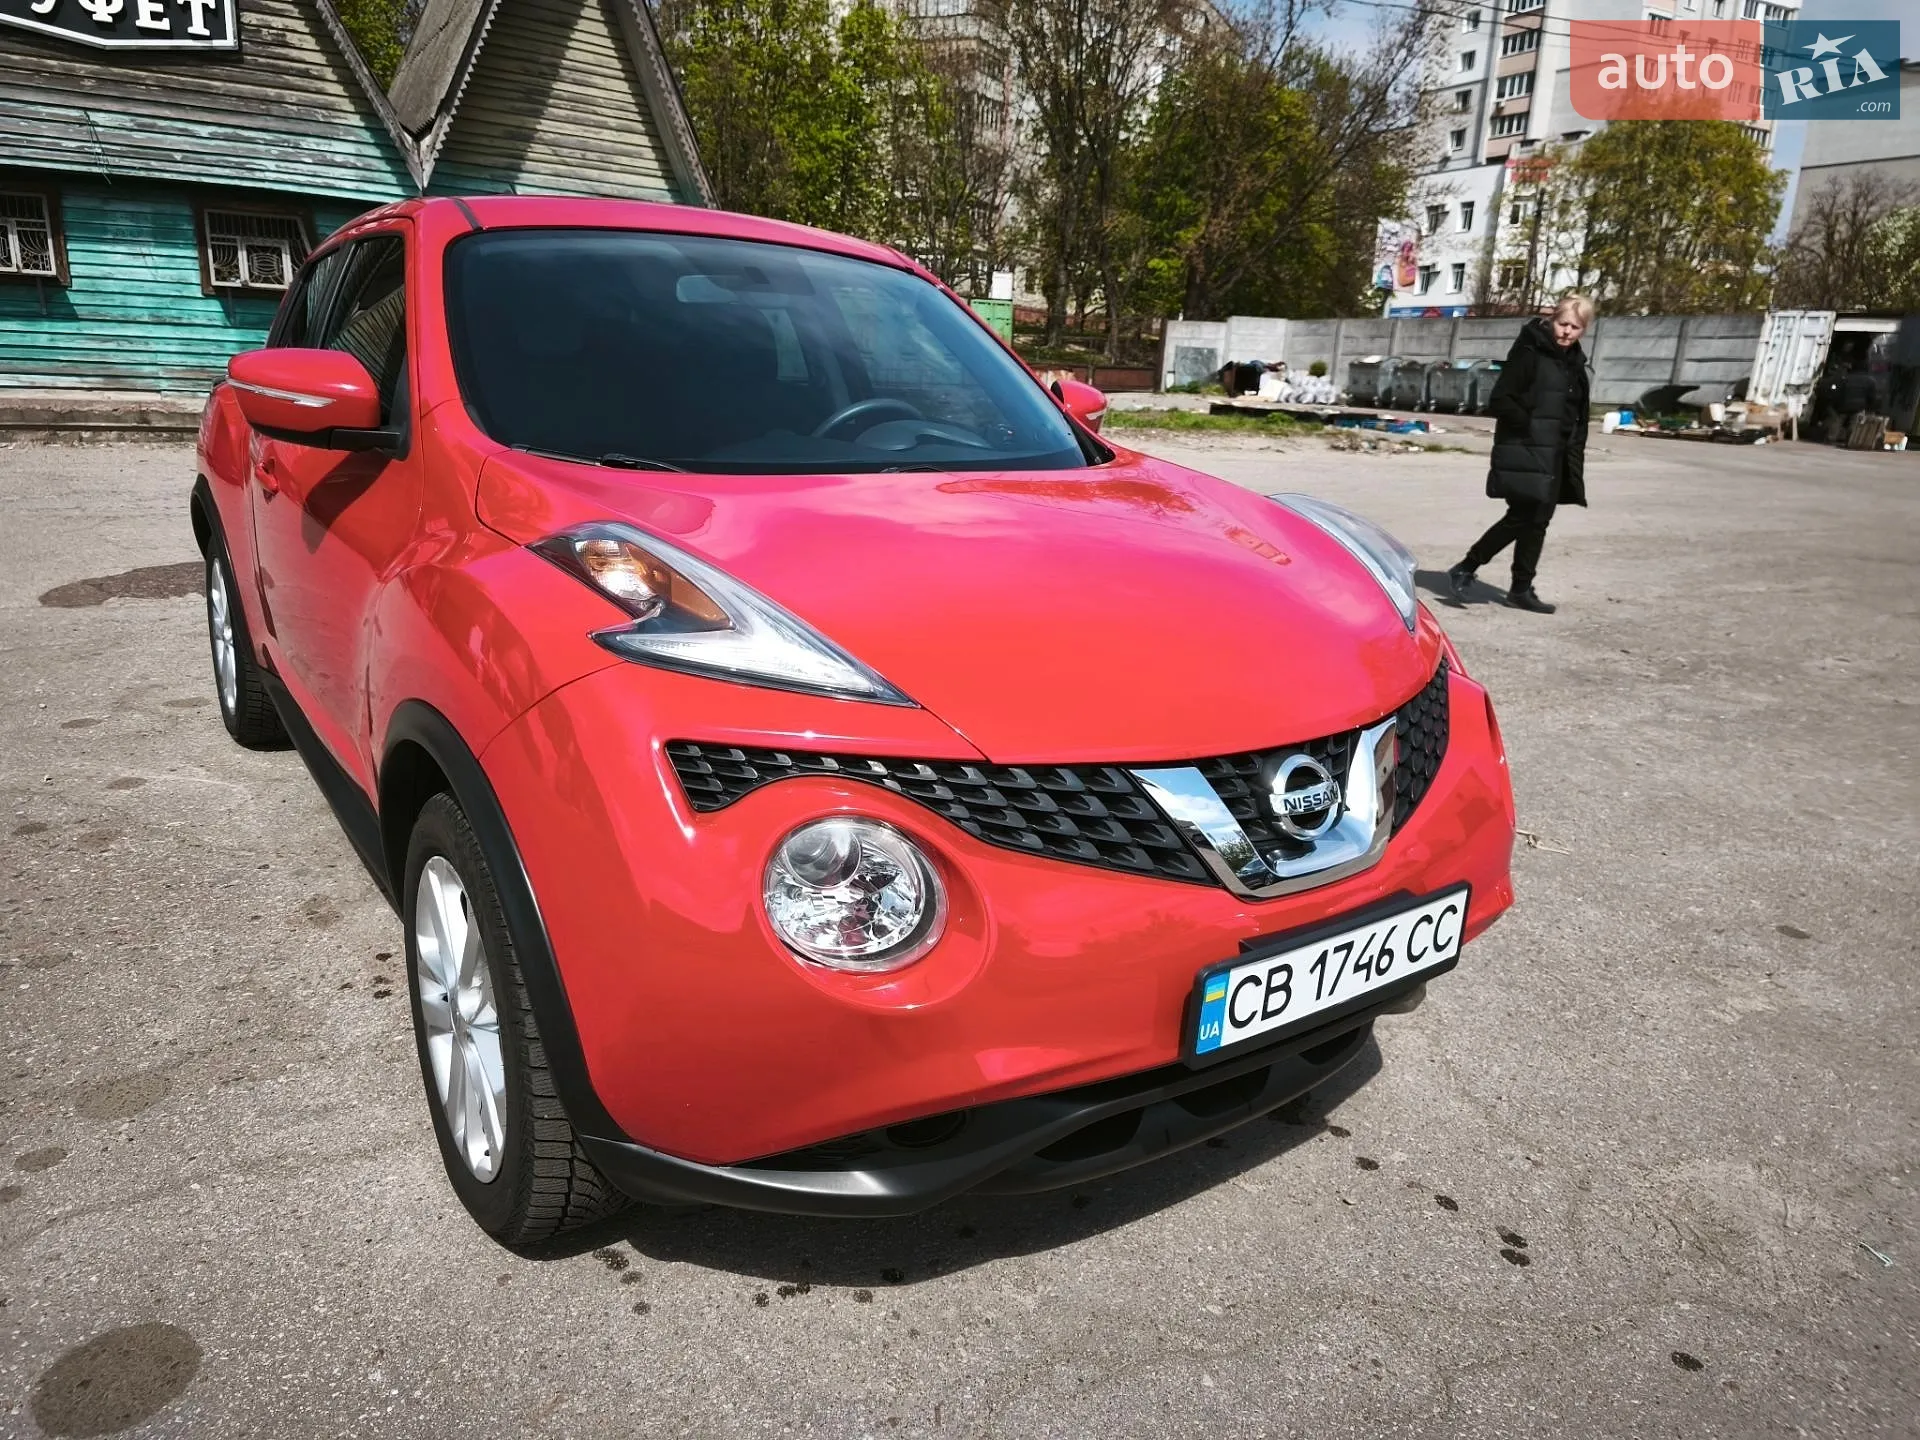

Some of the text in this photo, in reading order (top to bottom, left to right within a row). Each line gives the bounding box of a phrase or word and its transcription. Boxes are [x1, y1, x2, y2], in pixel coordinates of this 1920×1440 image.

[1284, 787, 1339, 811] NISSAN
[1229, 904, 1458, 1029] CB 1746 CC
[1200, 1022, 1220, 1040] UA
